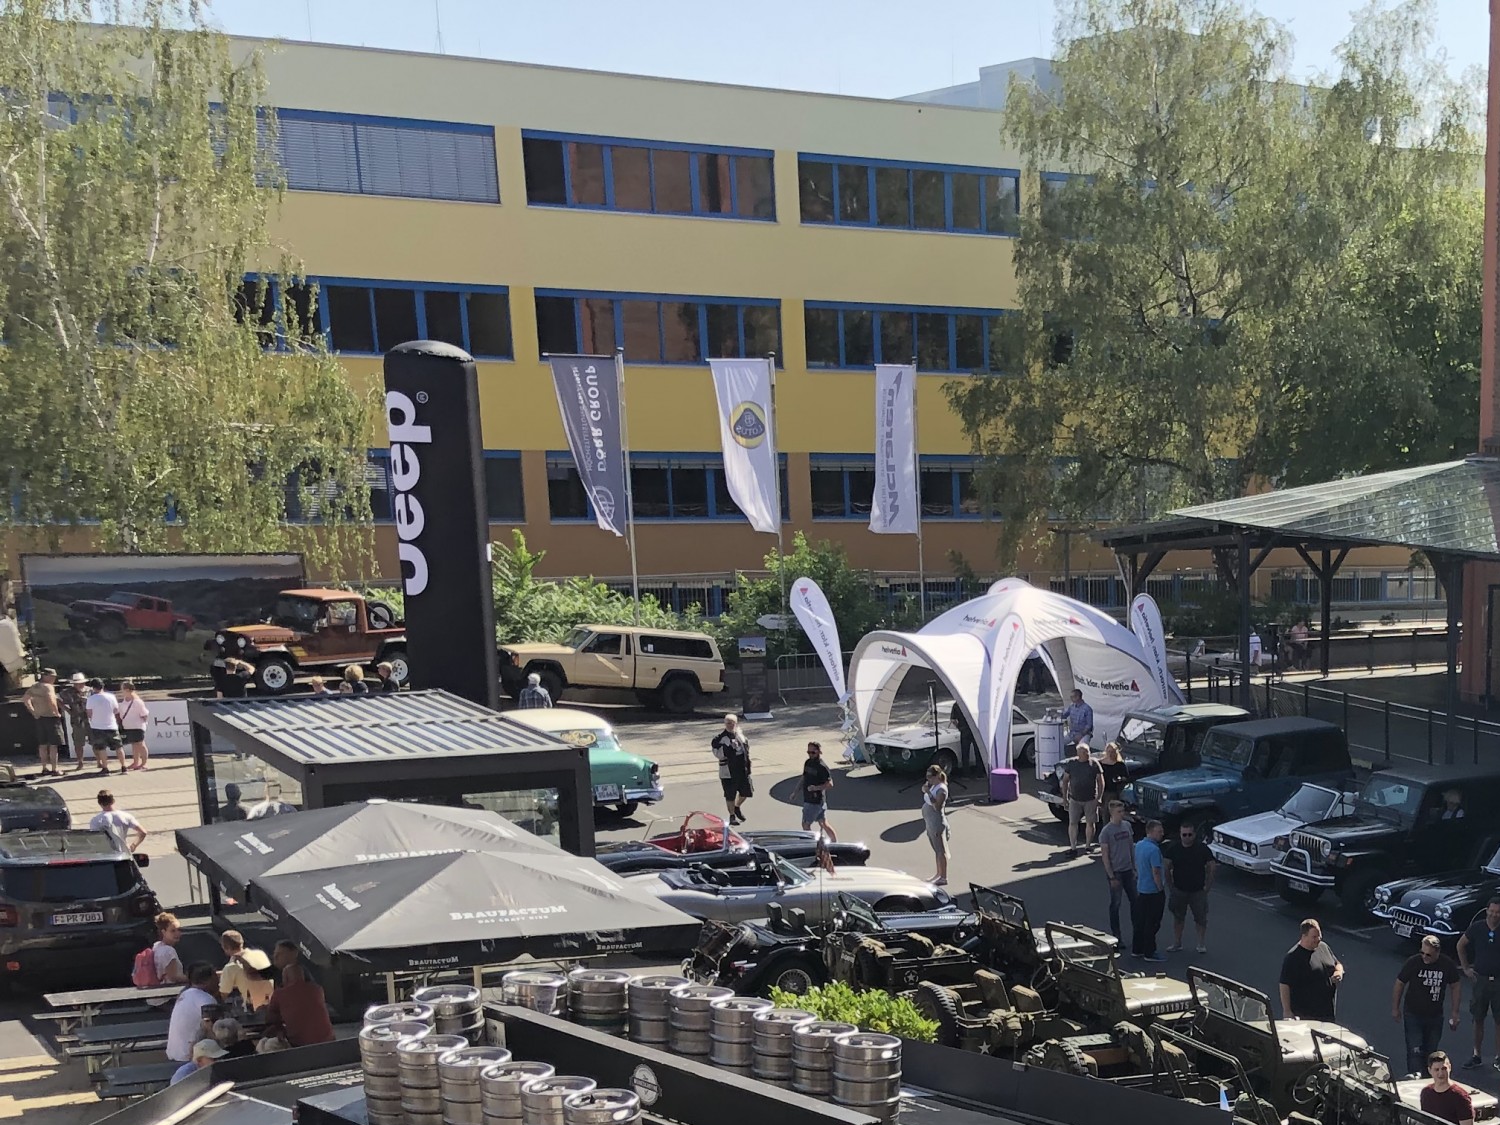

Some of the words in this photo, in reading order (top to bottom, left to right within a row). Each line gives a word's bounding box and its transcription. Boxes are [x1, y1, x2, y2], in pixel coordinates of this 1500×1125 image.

[386, 390, 432, 596] Jeep
[881, 645, 900, 656] helvetia
[1101, 681, 1130, 691] helvetia
[154, 716, 190, 726] KL
[157, 730, 190, 739] AUTO
[449, 905, 568, 921] BRAUFACTUM
[596, 942, 643, 951] BRAUFACTUM
[1423, 978, 1443, 986] JEEP
